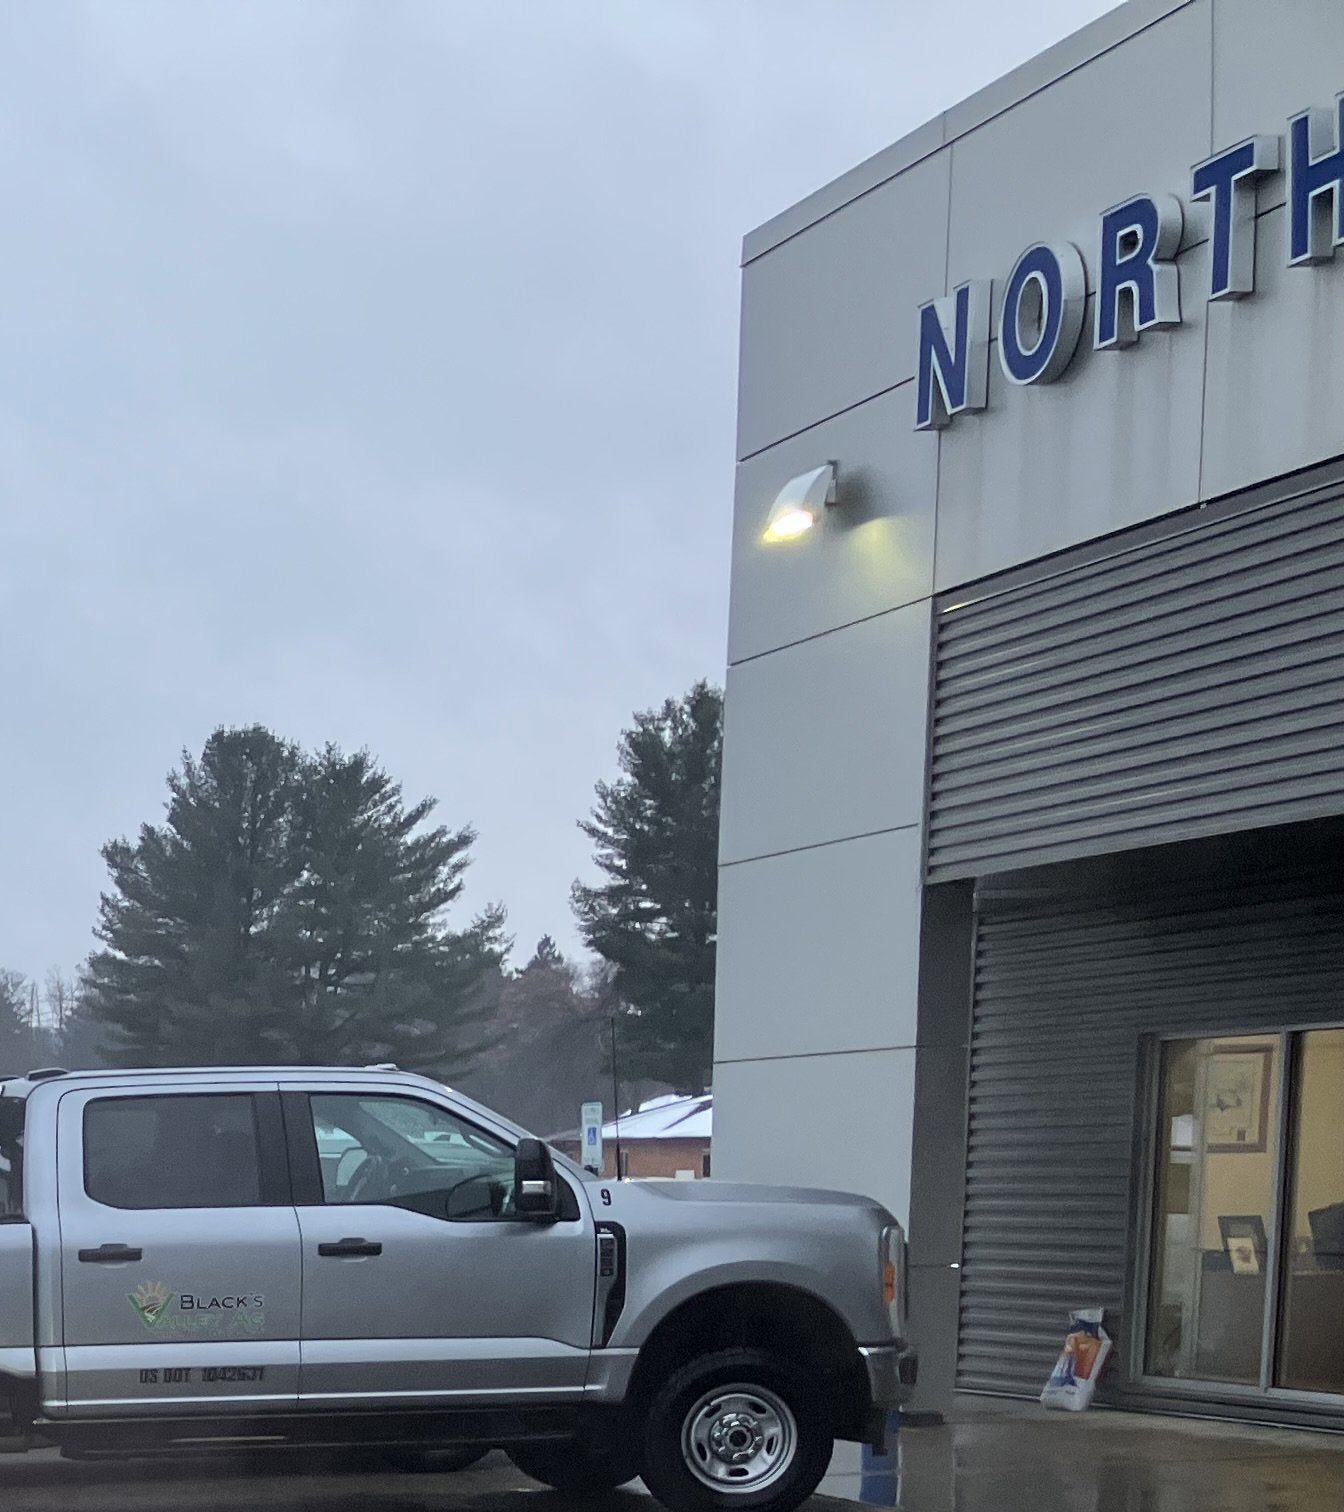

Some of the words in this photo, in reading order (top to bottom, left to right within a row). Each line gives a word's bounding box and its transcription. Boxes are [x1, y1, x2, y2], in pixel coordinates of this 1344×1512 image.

[914, 93, 1344, 431] NORTH
[600, 1188, 612, 1207] 9
[163, 1367, 192, 1384] DOT
